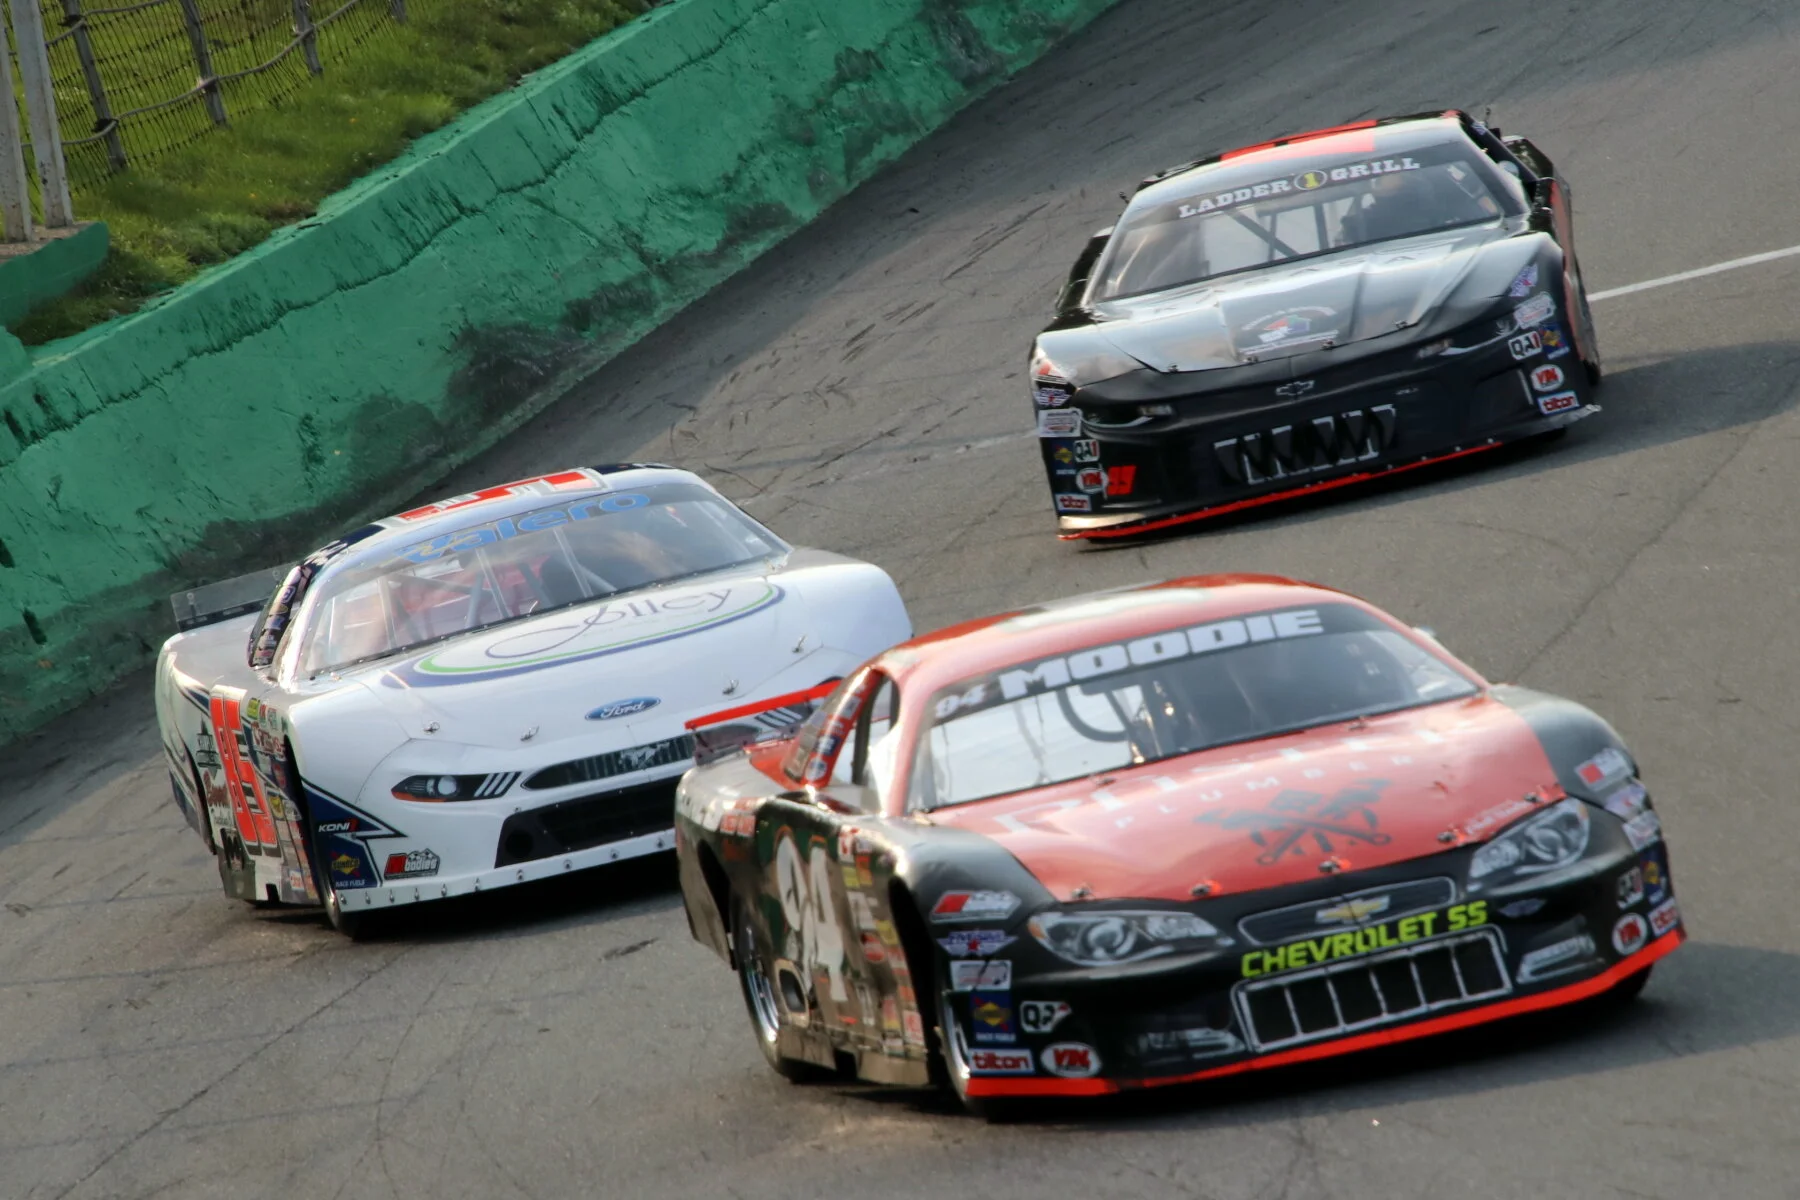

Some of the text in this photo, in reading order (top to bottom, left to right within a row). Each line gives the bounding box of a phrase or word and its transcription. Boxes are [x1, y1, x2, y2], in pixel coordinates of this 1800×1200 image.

[1178, 157, 1421, 219] LADDER 1 GRILL
[999, 609, 1325, 700] MOODIE
[600, 701, 645, 719] Ford
[318, 822, 351, 833] KONI
[1241, 900, 1489, 979] CHEVROLET SS
